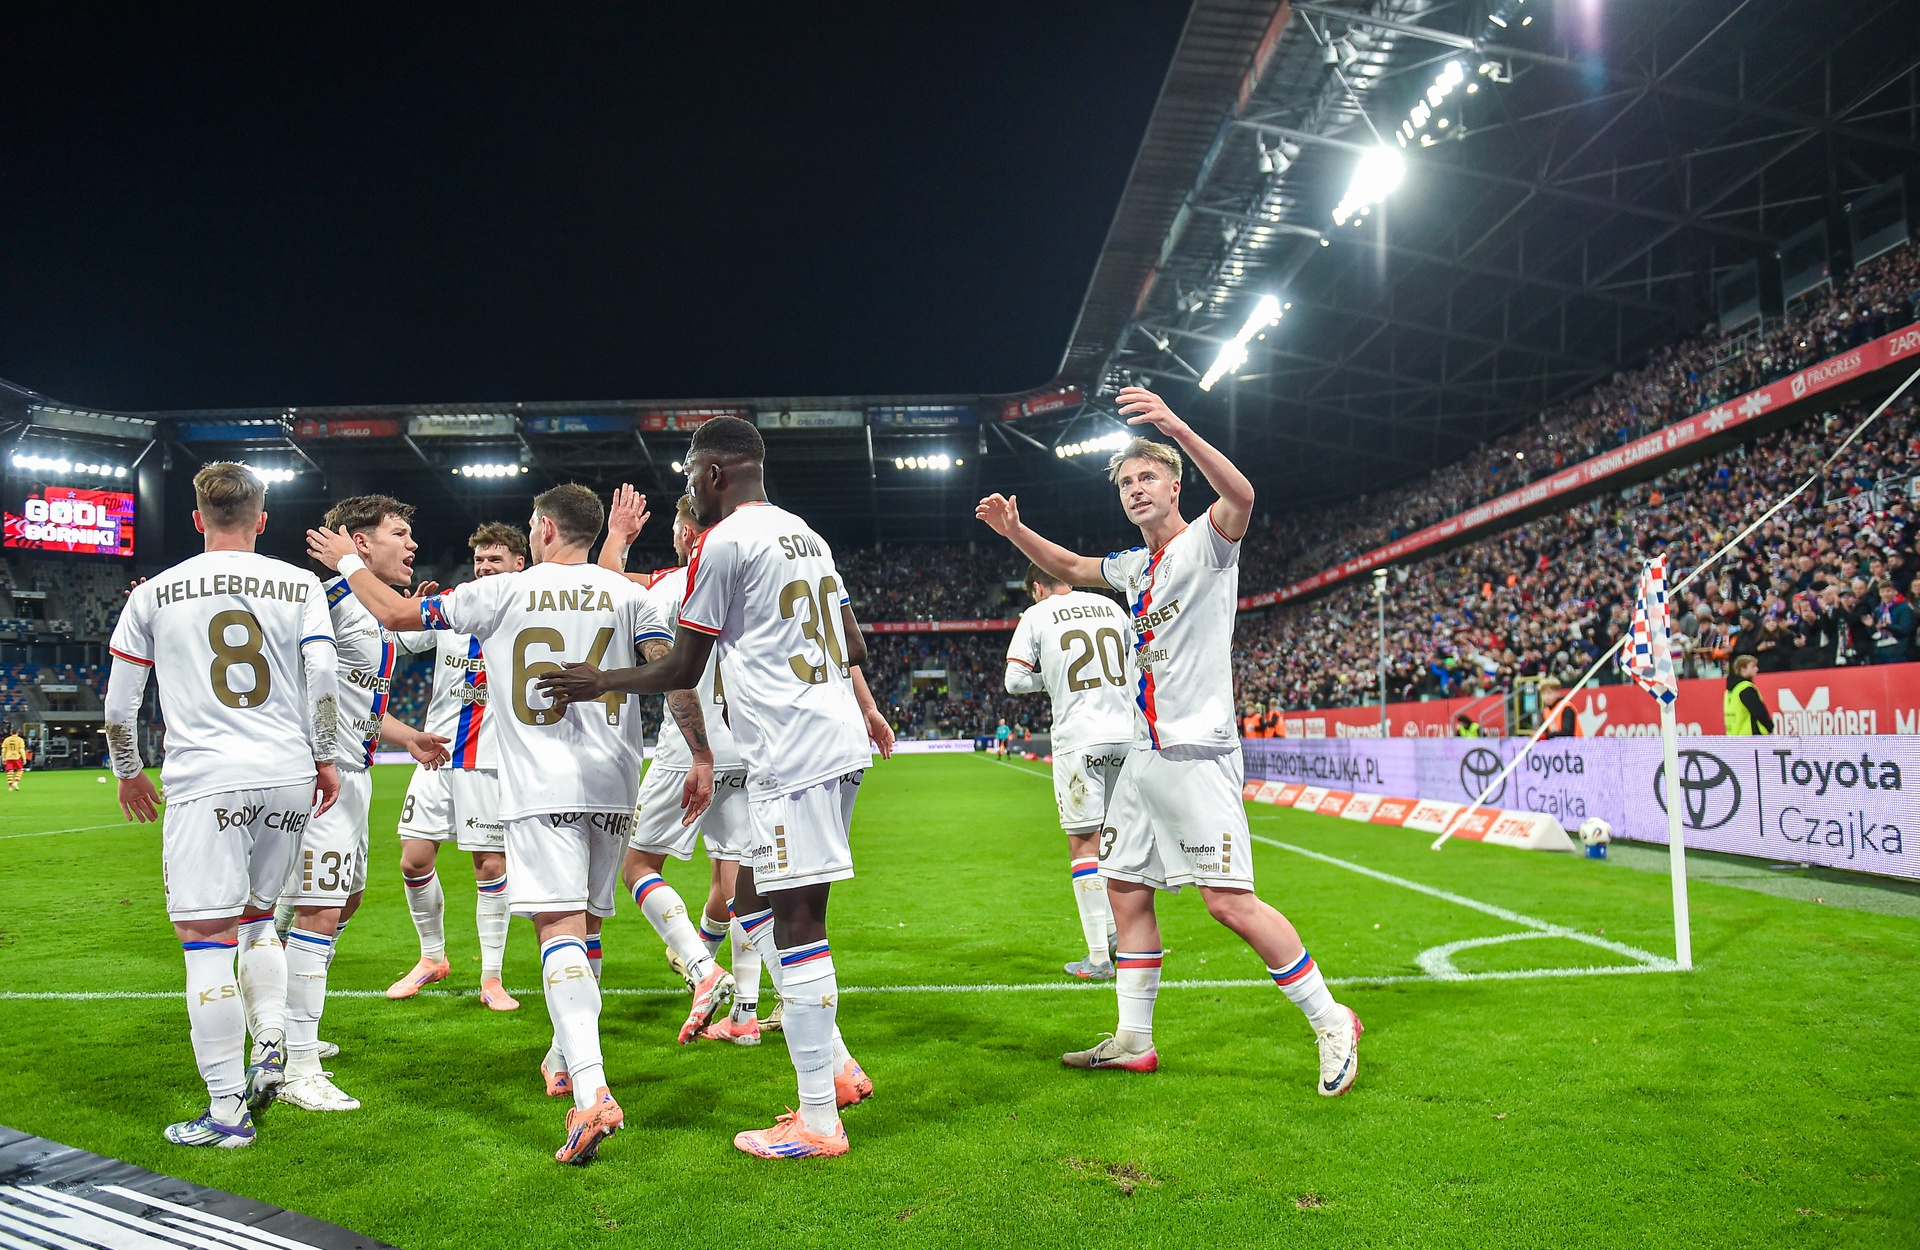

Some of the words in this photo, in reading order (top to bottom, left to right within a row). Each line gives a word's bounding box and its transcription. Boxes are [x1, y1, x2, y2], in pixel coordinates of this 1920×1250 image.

[1806, 353, 1861, 386] PROGRESS
[779, 534, 822, 560] SOW
[156, 574, 309, 608] HELLEBRAND
[526, 584, 614, 612] JANŽA
[779, 575, 851, 685] 30
[1053, 605, 1115, 625] JOSEMA
[209, 610, 271, 708] 8
[1060, 627, 1128, 693] 20
[512, 627, 628, 726] 64
[1896, 708, 1920, 735] M
[1526, 749, 1584, 778] Toyota
[1773, 749, 1902, 796] Toyota
[214, 805, 264, 832] BODY
[402, 795, 416, 824] 8
[1412, 807, 1450, 824] STIHL
[1526, 786, 1587, 822] Czajka
[1493, 820, 1537, 839] STIHL
[1779, 807, 1903, 860] Czajka
[318, 851, 352, 892] 33
[199, 984, 236, 1006] KS
